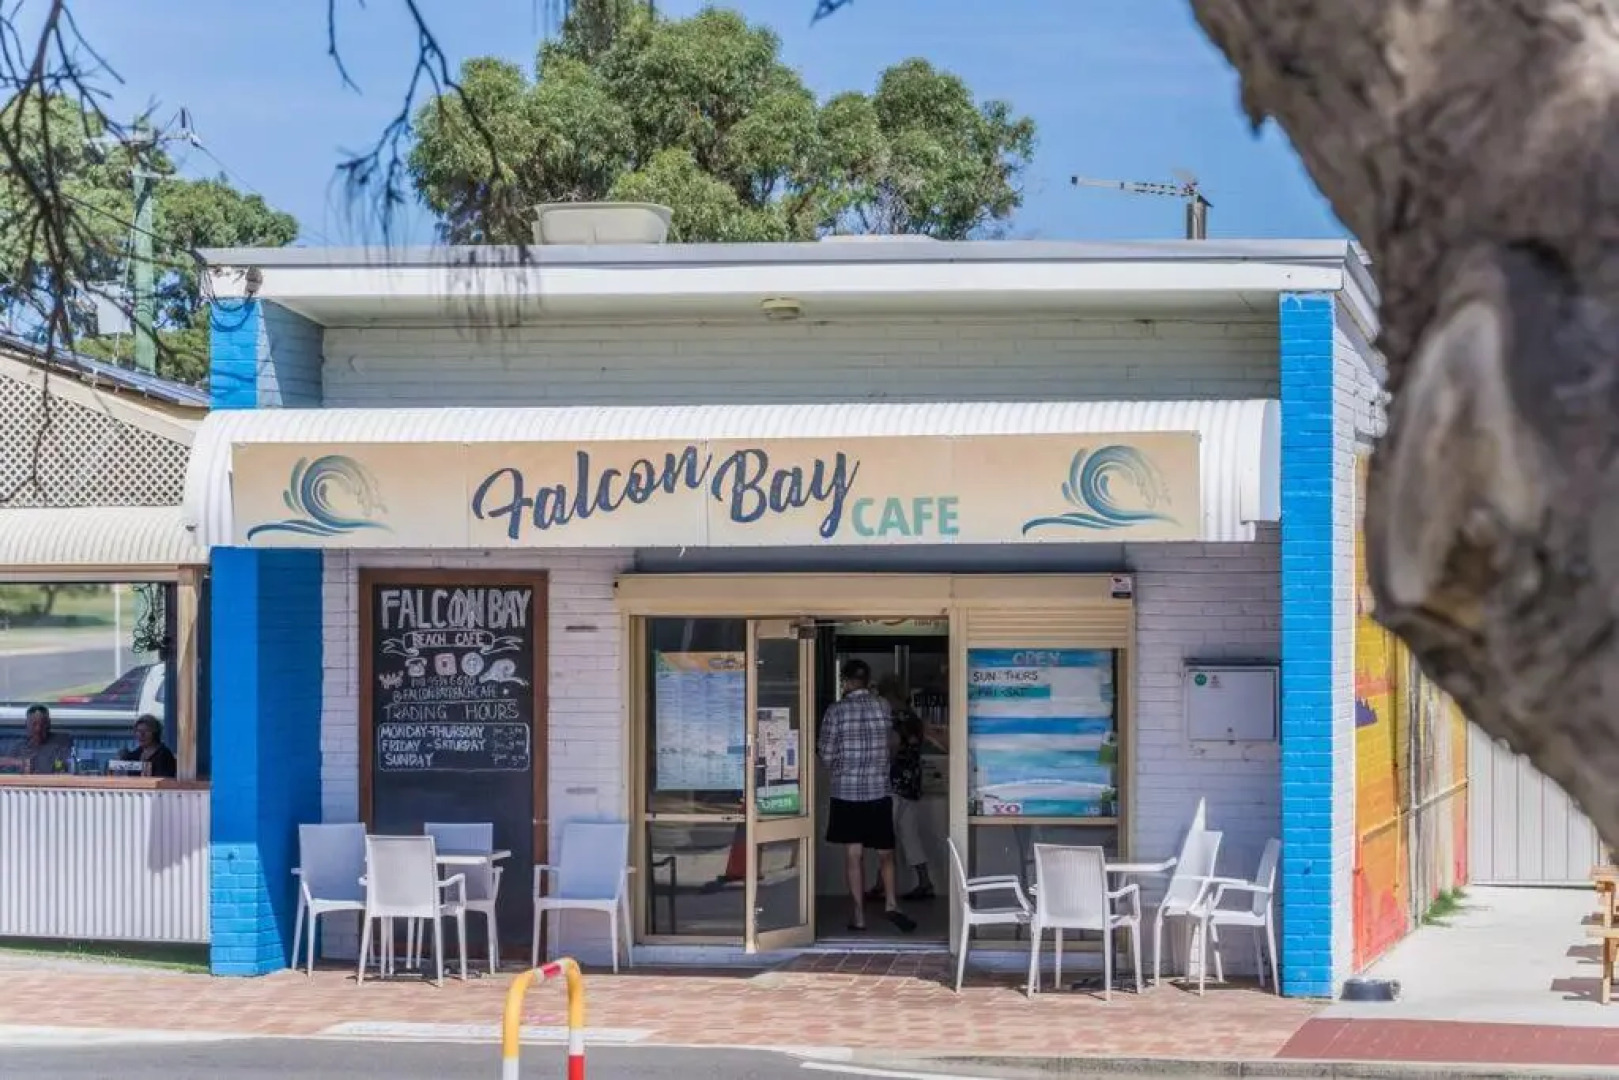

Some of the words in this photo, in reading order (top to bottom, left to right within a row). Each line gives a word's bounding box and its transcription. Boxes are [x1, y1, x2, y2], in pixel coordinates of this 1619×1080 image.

[472, 445, 713, 539] Falcon
[711, 447, 860, 539] Bay
[851, 496, 960, 537] CAFE
[380, 588, 485, 629] FALCON
[488, 589, 532, 629] BAY
[412, 631, 446, 646] BEACH
[454, 631, 484, 646] CAFE
[973, 670, 996, 682] SUN
[1003, 670, 1038, 681] THURS
[384, 703, 447, 721] TRADING
[464, 703, 519, 720] HOURS
[382, 739, 421, 752] FRIDAY
[434, 738, 487, 752] SATURDAY
[385, 753, 434, 767] SUNDAY
